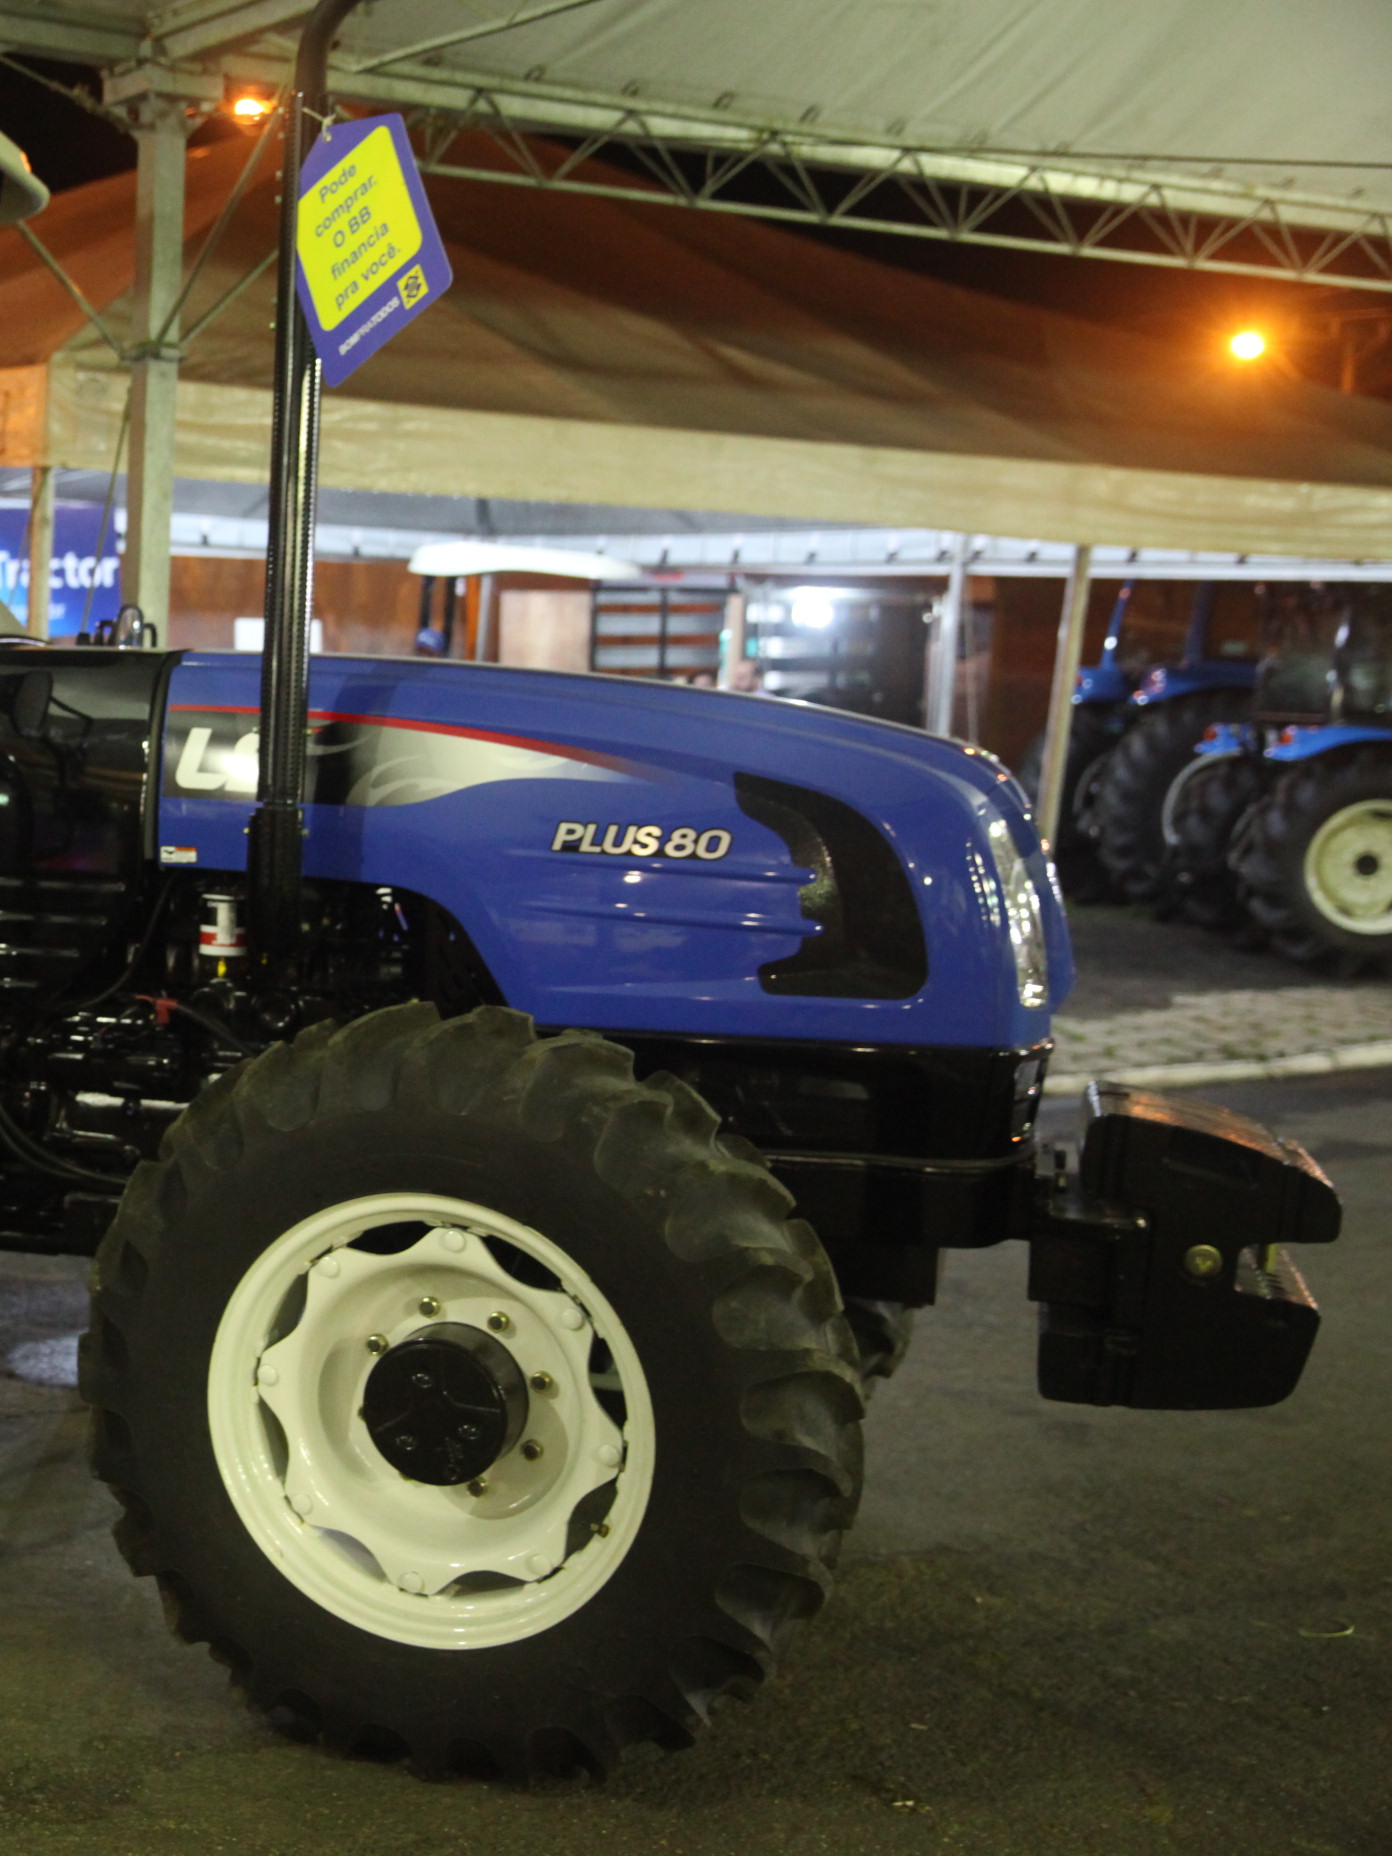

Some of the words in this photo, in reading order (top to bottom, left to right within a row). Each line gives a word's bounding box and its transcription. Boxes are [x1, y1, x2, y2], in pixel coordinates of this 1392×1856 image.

[315, 174, 378, 238] comprar.
[319, 164, 357, 203] Pode
[331, 222, 390, 280] financia
[333, 230, 346, 248] O
[349, 206, 372, 235] BB
[335, 281, 359, 311] pra
[361, 243, 401, 281] você.
[551, 821, 662, 857] PLUS
[664, 826, 732, 860] 80
